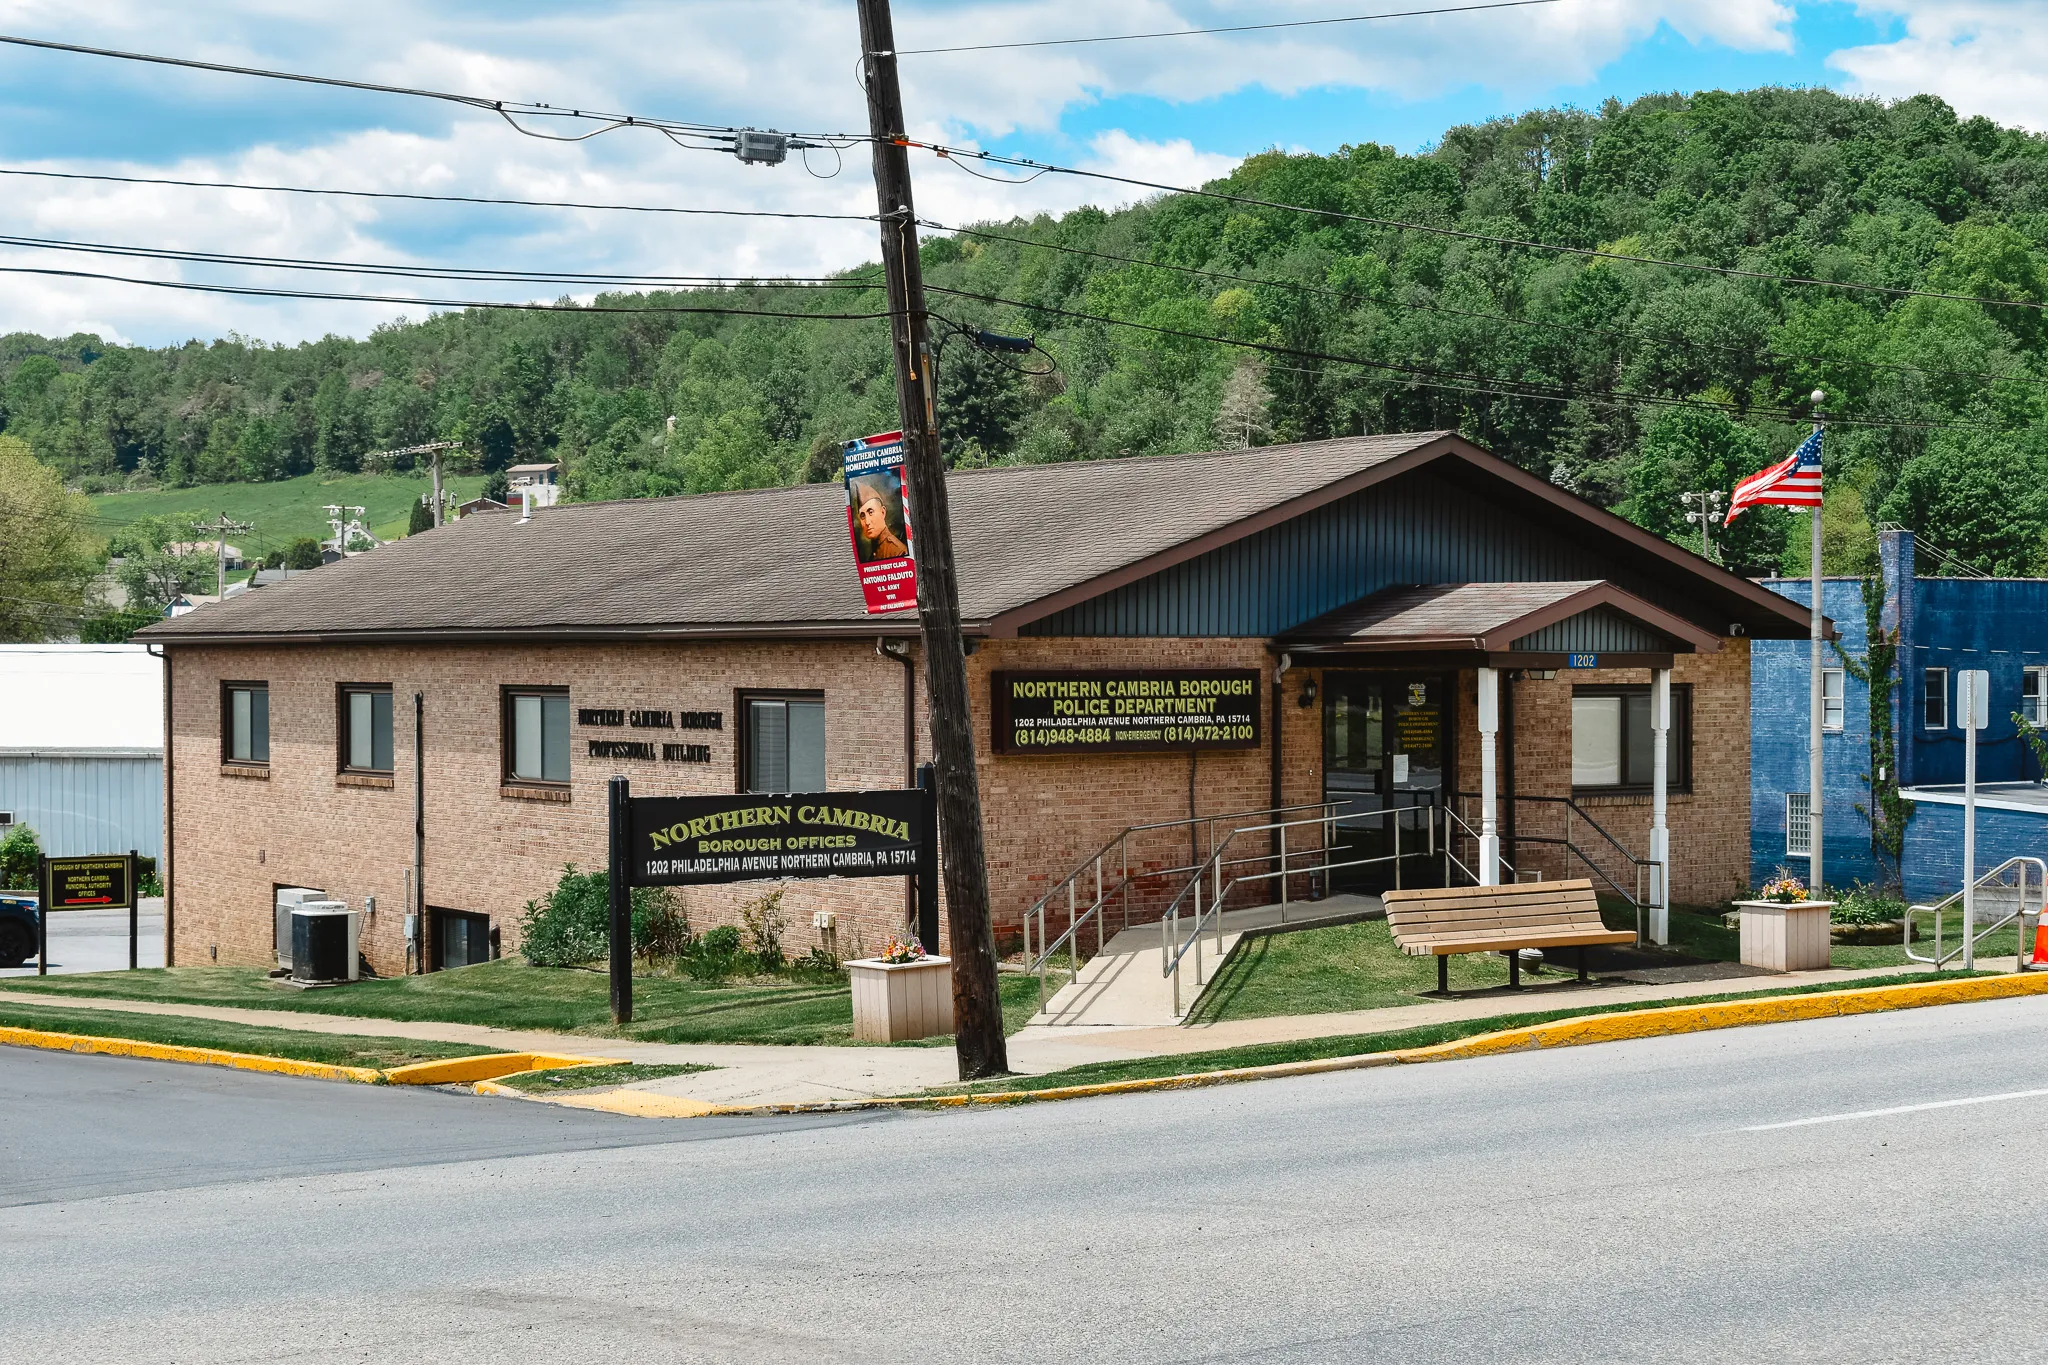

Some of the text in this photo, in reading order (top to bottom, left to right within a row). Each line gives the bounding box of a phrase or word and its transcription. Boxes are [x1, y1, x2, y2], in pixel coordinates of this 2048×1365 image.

[846, 446, 902, 464] NORTHERN CAMBRIA
[846, 454, 904, 472] HOMETOWN HEROES
[864, 570, 914, 584] ANTONIO FALDUTO
[1574, 654, 1594, 666] 1202
[1013, 680, 1252, 698] NORTHERN CAMBRIA BOROUGH
[1054, 698, 1216, 715] POLICE DEPARTMENT
[629, 710, 675, 728] CAMBRIA
[680, 711, 723, 730] BOROUGH
[1014, 718, 1034, 726] 1202
[1036, 718, 1096, 726] PHILADELPHIA
[1098, 716, 1130, 726] AVENUE
[1132, 716, 1176, 724] NORTHERN
[1178, 716, 1214, 724] CAMBRIA,
[1228, 714, 1250, 723] 15714
[1015, 726, 1254, 746] (814)948-4884 NON-EMERGENCY (814)472-2100
[588, 740, 711, 763] PROFESSIONAL BUILDING
[649, 805, 910, 851] NORTHERN CAMBRIA
[698, 835, 857, 853] BOROUGH OFFICES
[646, 850, 916, 875] 1202 PHILADELPHIA AVENUE NORTHERN CAMBRIA, PA 15714
